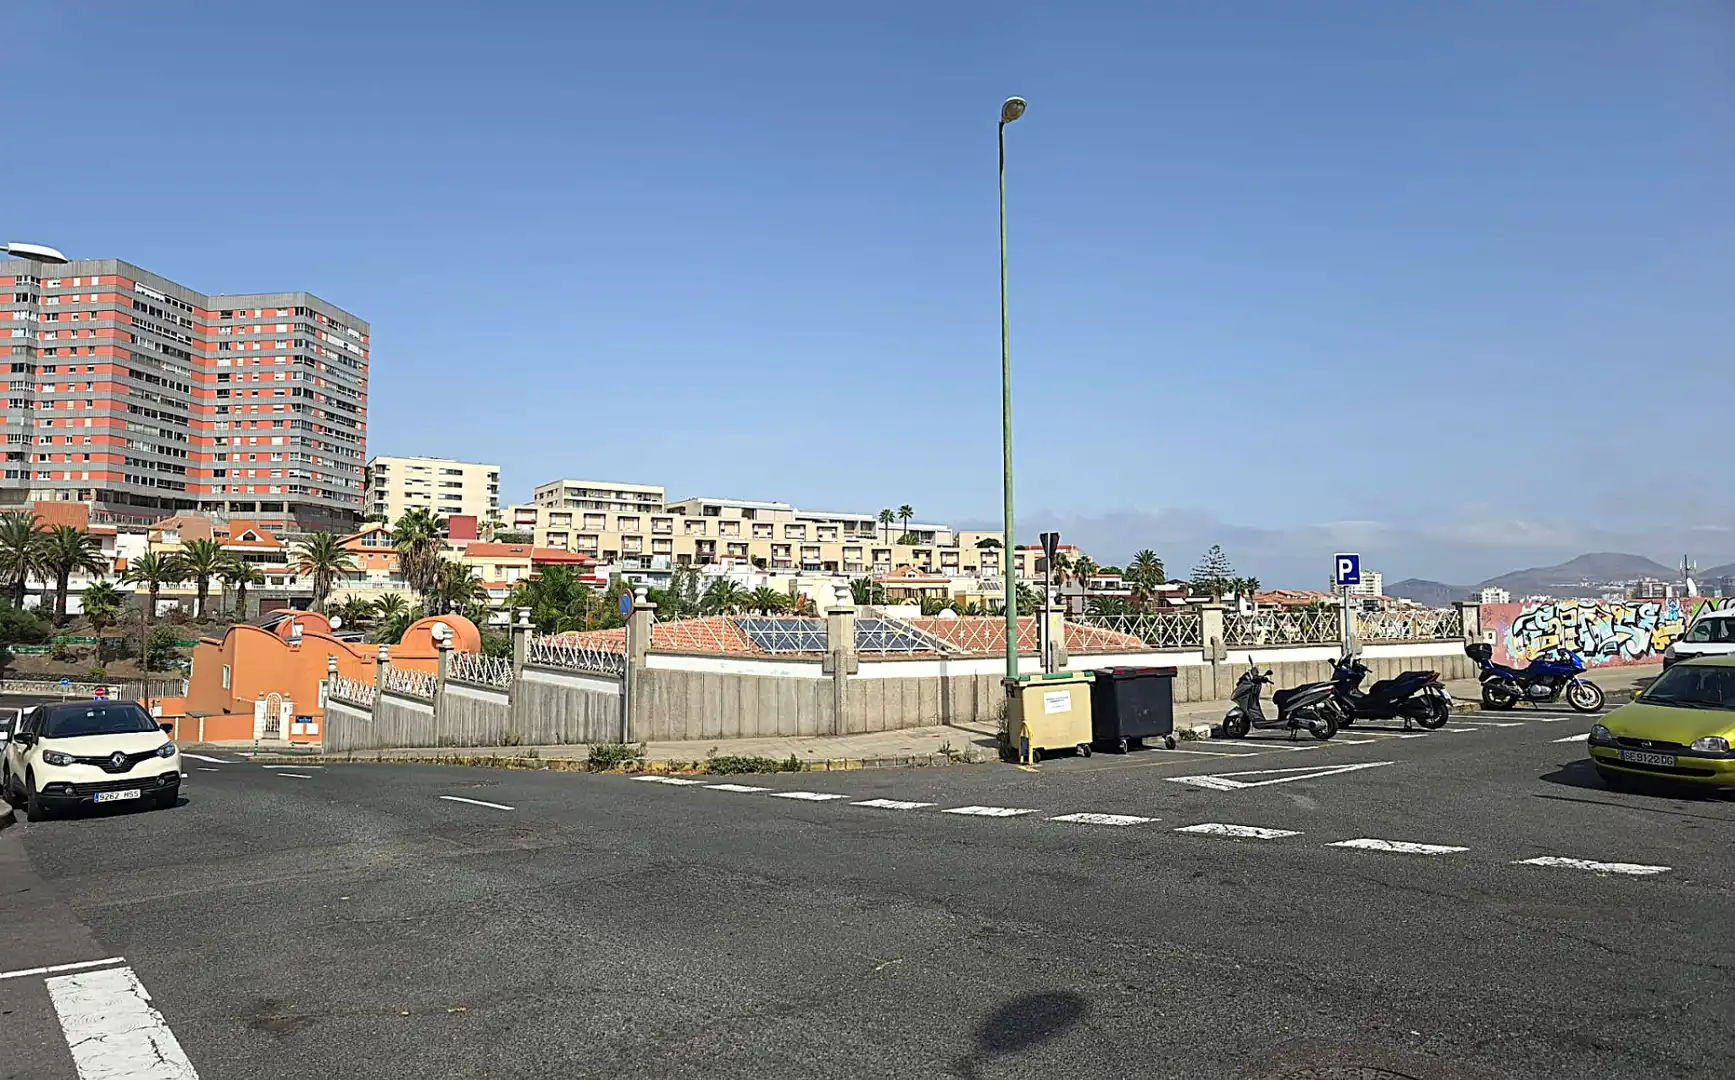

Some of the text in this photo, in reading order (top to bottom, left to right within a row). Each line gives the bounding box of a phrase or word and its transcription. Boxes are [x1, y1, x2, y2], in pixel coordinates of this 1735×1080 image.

[1339, 559, 1353, 581] P
[1625, 752, 1673, 766] SE 9122 DG
